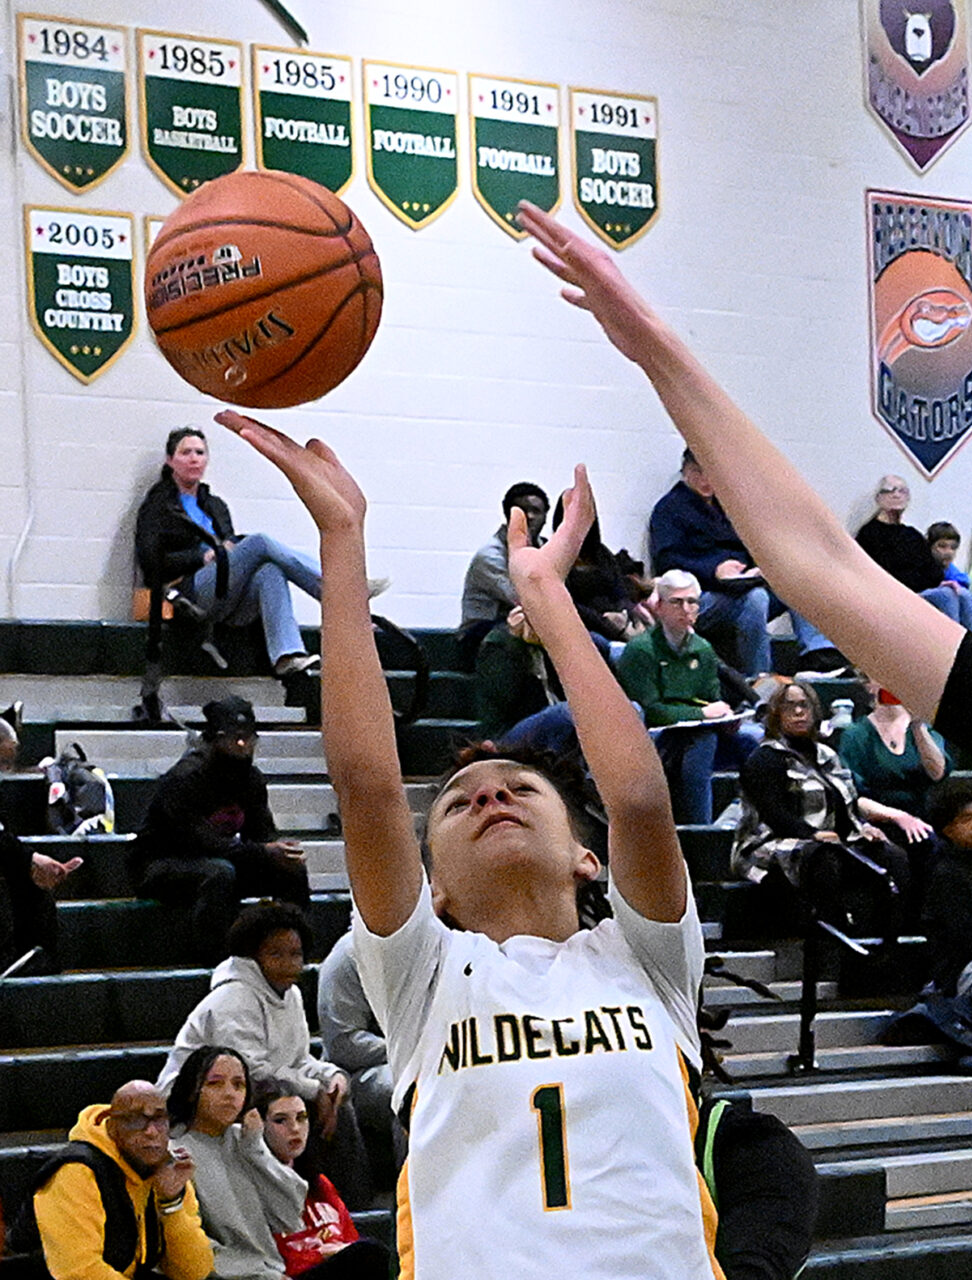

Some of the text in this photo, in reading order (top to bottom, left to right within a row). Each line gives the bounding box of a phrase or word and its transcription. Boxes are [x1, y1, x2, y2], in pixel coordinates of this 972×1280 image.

[40, 28, 109, 62] 1984
[159, 44, 225, 77] 1985
[273, 59, 336, 91] 1985
[45, 78, 108, 112] BOYS
[383, 74, 442, 103] 1990
[490, 90, 540, 116] 1991
[31, 109, 123, 147] SOCCER
[172, 106, 217, 131] BOYS
[590, 103, 639, 128] 1991
[153, 128, 238, 153] BASKETBALL
[264, 117, 349, 147] FOOTBALL
[373, 130, 456, 159] FOOTBALL
[478, 147, 555, 176] FOOTBALL
[591, 148, 641, 177] BOYS
[579, 177, 655, 209] SOCCER
[48, 222, 115, 250] 2005
[57, 264, 109, 288] BOYS
[55, 289, 112, 311] CROSS
[44, 309, 124, 332] COUNTRY
[530, 1081, 573, 1212] 1
